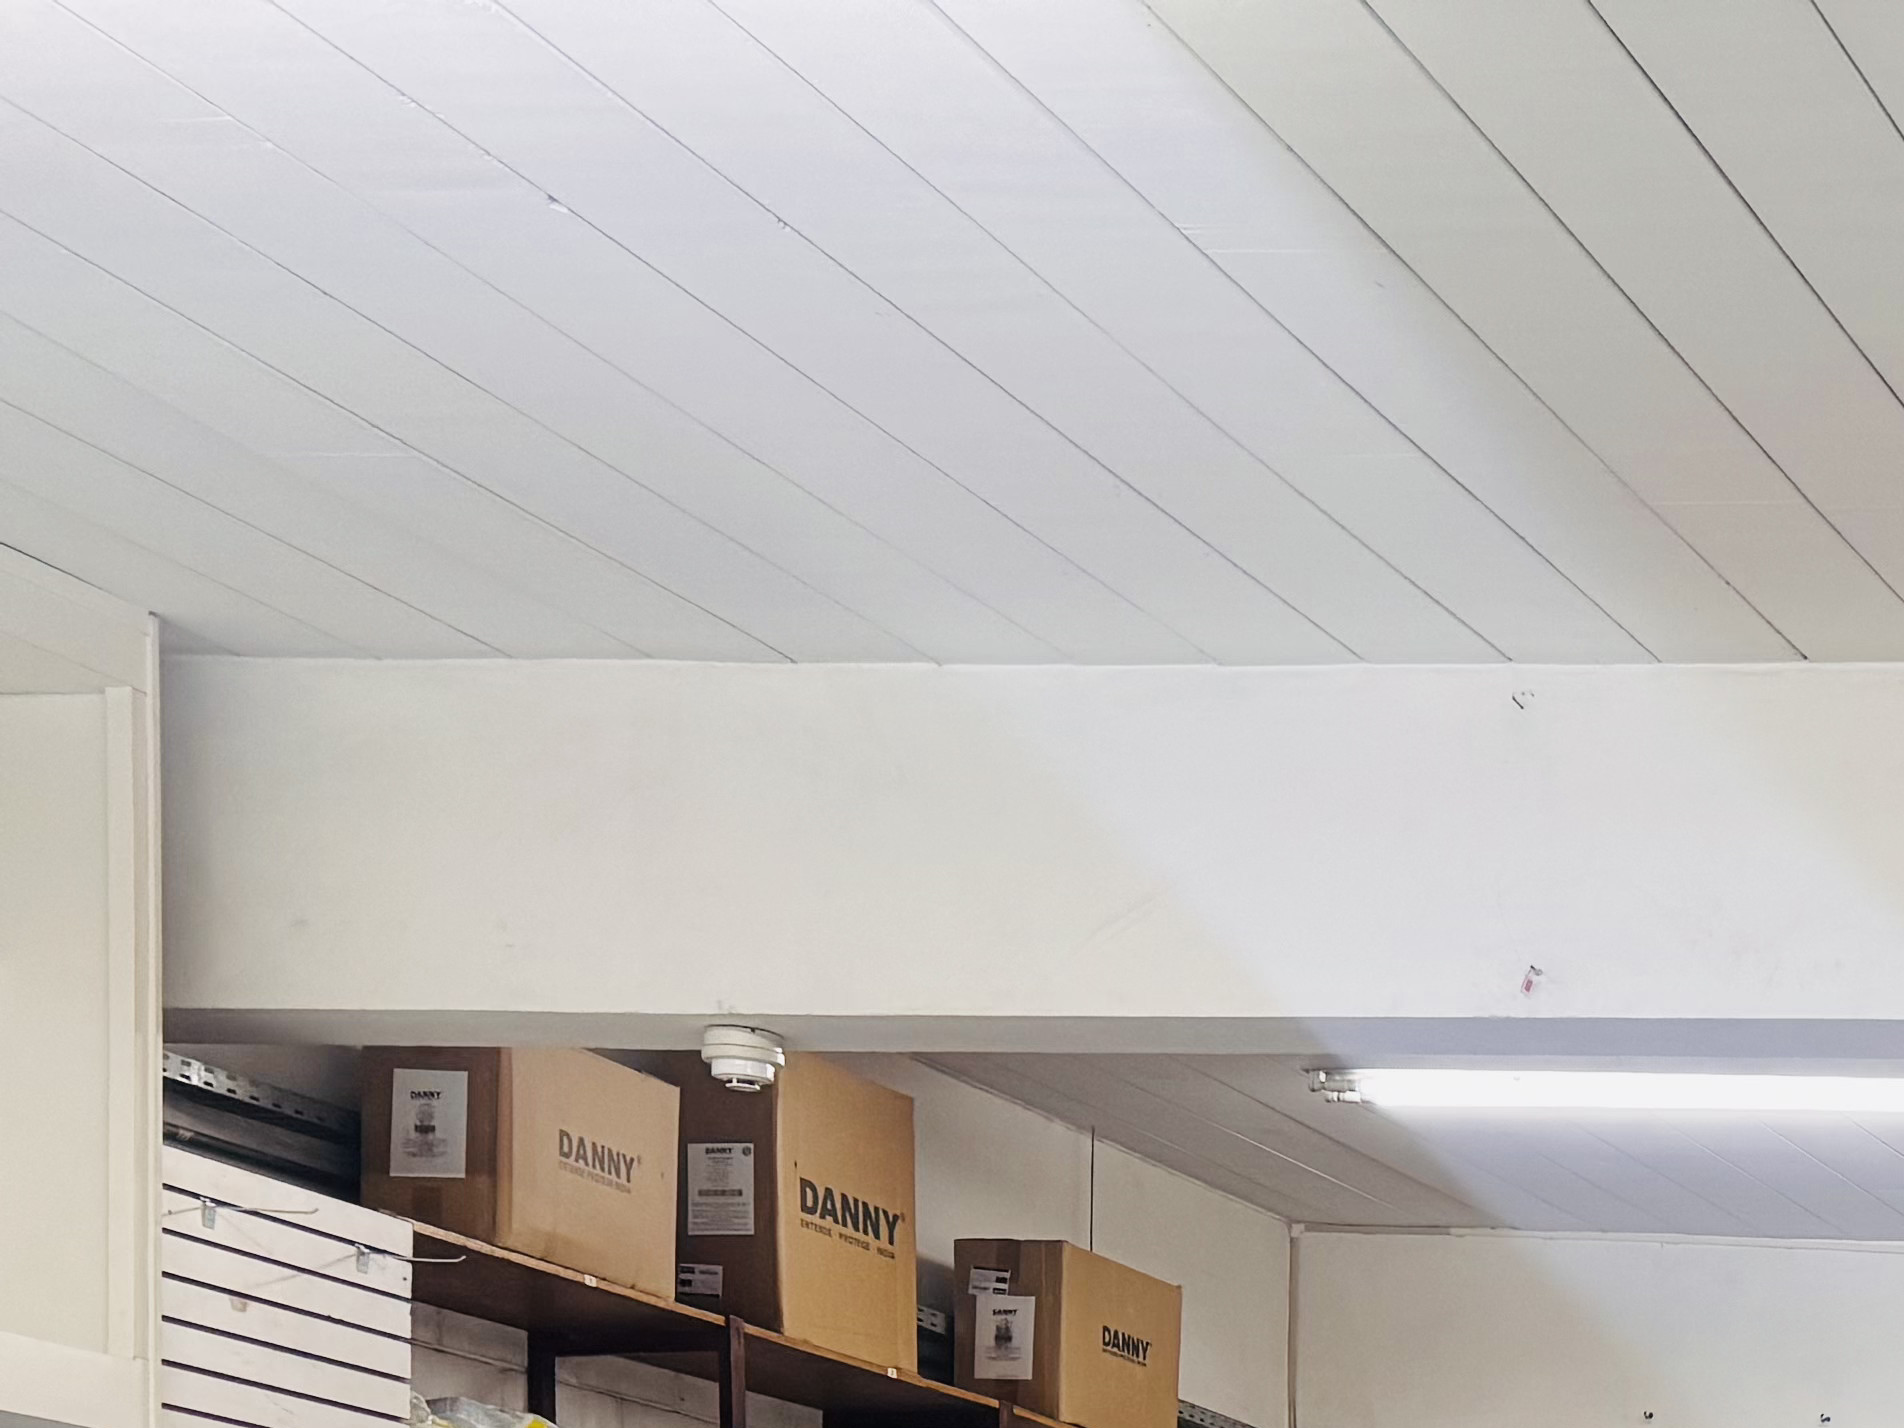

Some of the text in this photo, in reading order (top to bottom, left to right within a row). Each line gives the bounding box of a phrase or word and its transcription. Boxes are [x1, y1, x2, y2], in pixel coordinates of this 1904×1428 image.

[559, 1128, 635, 1184] DANNY
[800, 1176, 900, 1247] DANNY
[1102, 1324, 1150, 1361] DANNY
